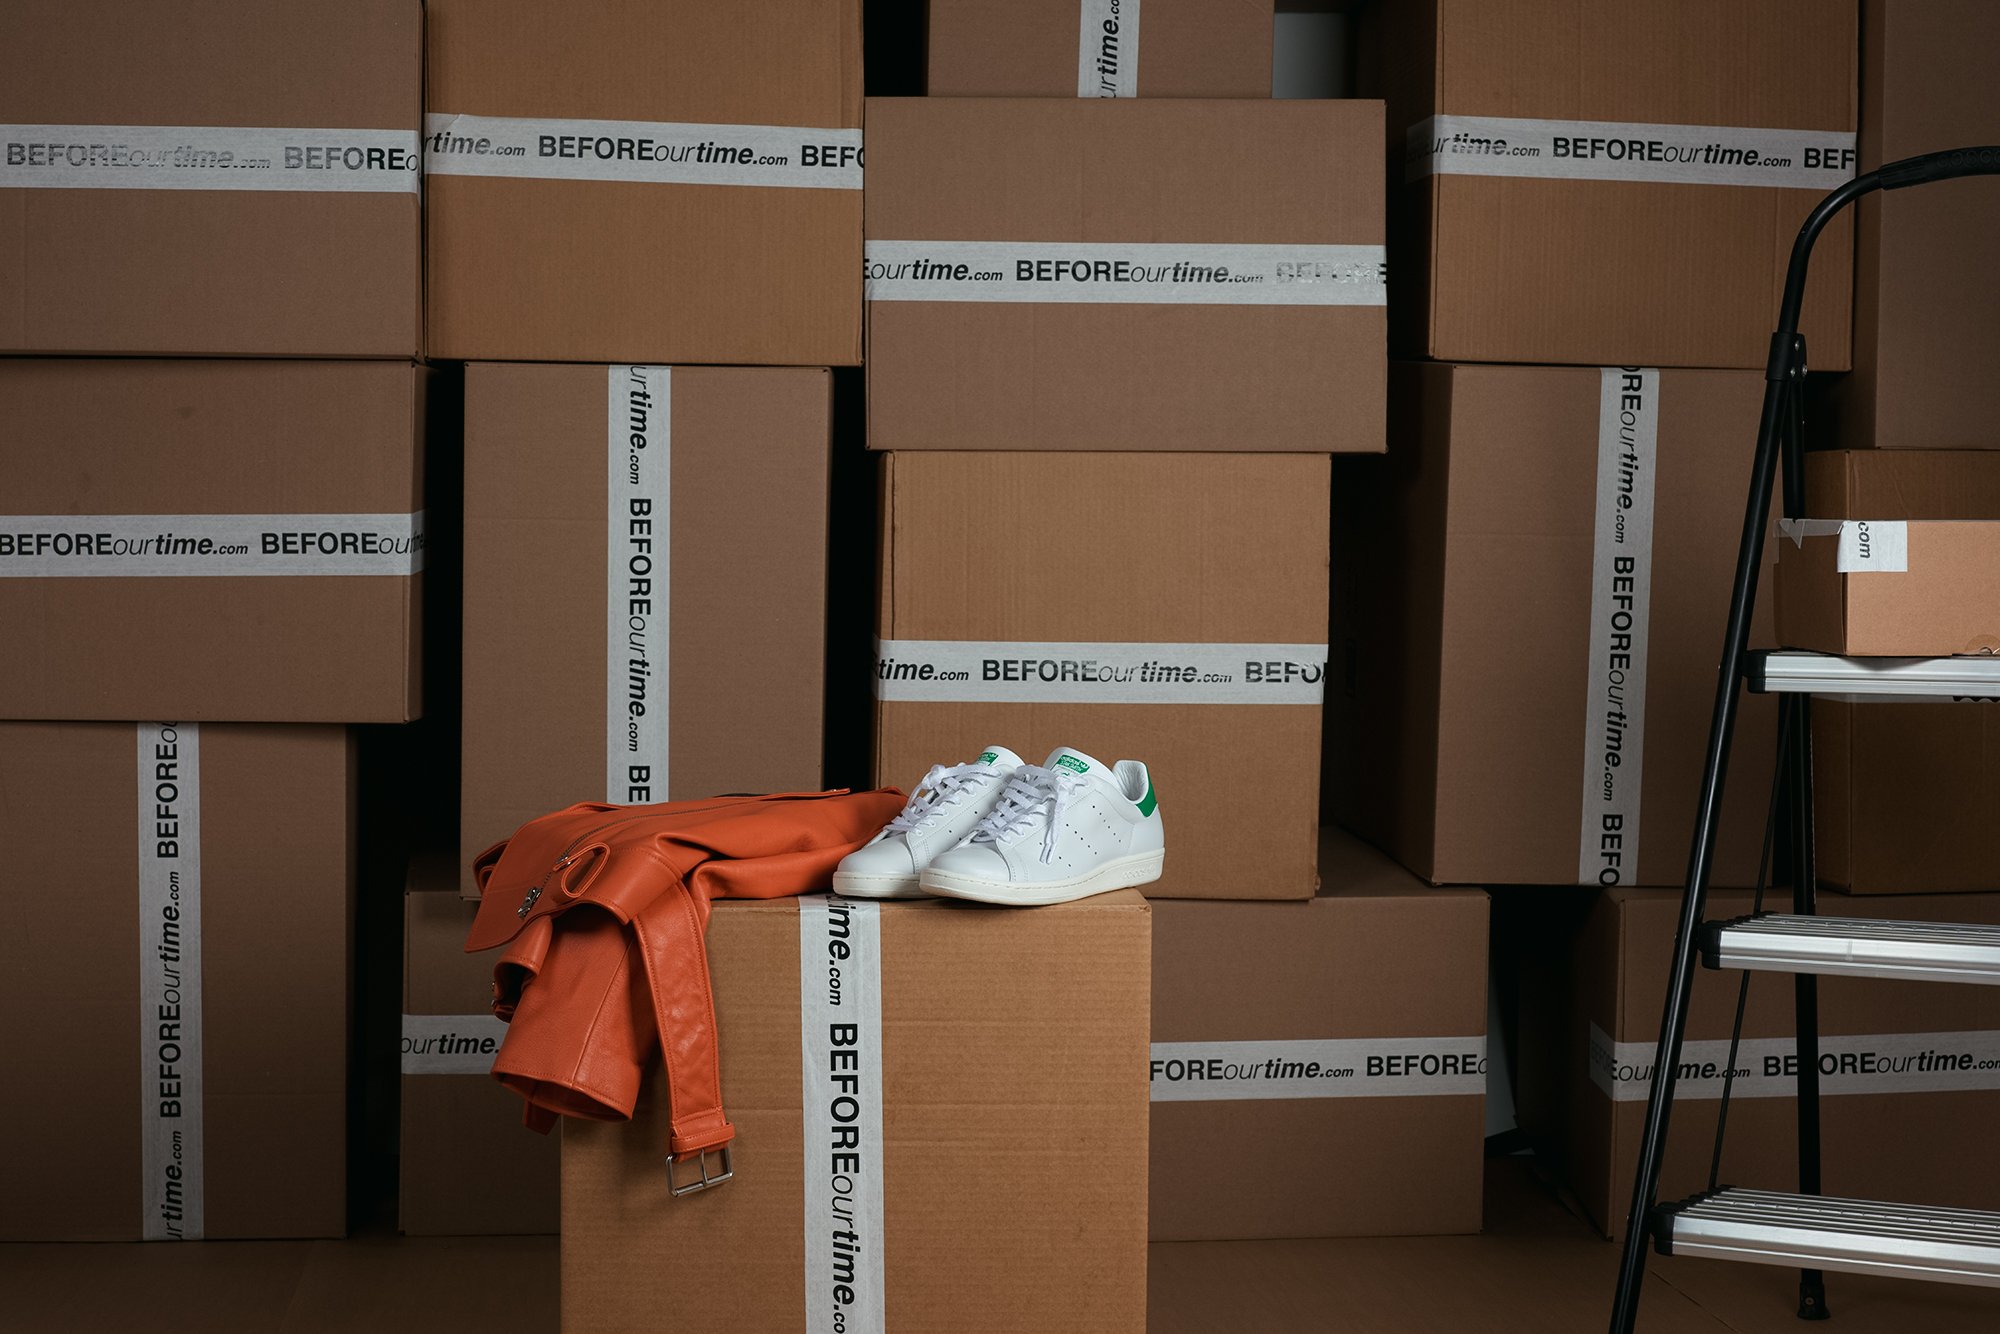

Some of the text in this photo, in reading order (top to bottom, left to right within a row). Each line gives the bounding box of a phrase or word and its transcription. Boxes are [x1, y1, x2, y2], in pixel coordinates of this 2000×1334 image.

[538, 135, 788, 166] BEFOREourtime.com
[1553, 137, 1791, 167] BEFOREourtime.com
[1016, 260, 1263, 284] BEFOREourtime.com
[1615, 367, 1642, 544] REourtime.com
[0, 533, 249, 556] BEFOREourtime.com
[628, 499, 652, 752] BEFOREourtime.com
[982, 660, 1232, 683] BEFOREourtime.com
[1246, 661, 1327, 684] BEFO
[1603, 557, 1634, 802] BEFOREourtime.com
[629, 766, 650, 802] BE
[157, 871, 181, 1118] BEFOREourtime.com
